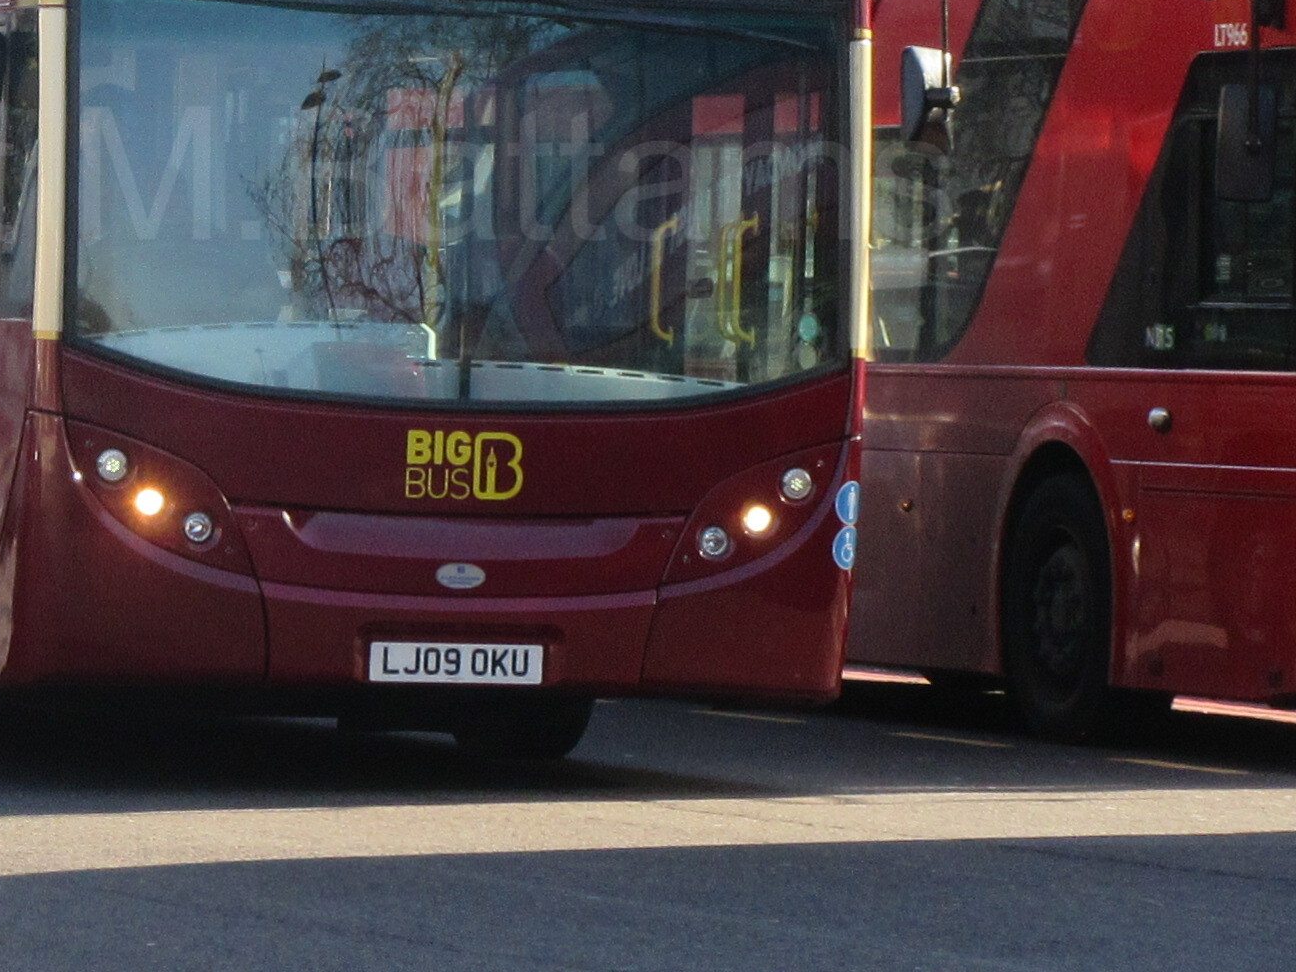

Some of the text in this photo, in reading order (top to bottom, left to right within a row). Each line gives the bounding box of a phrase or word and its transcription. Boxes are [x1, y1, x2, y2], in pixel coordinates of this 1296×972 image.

[1214, 24, 1249, 47] LT966
[406, 429, 472, 466] BIG
[405, 467, 471, 500] BUS
[382, 646, 530, 677] LJ09 OKU
